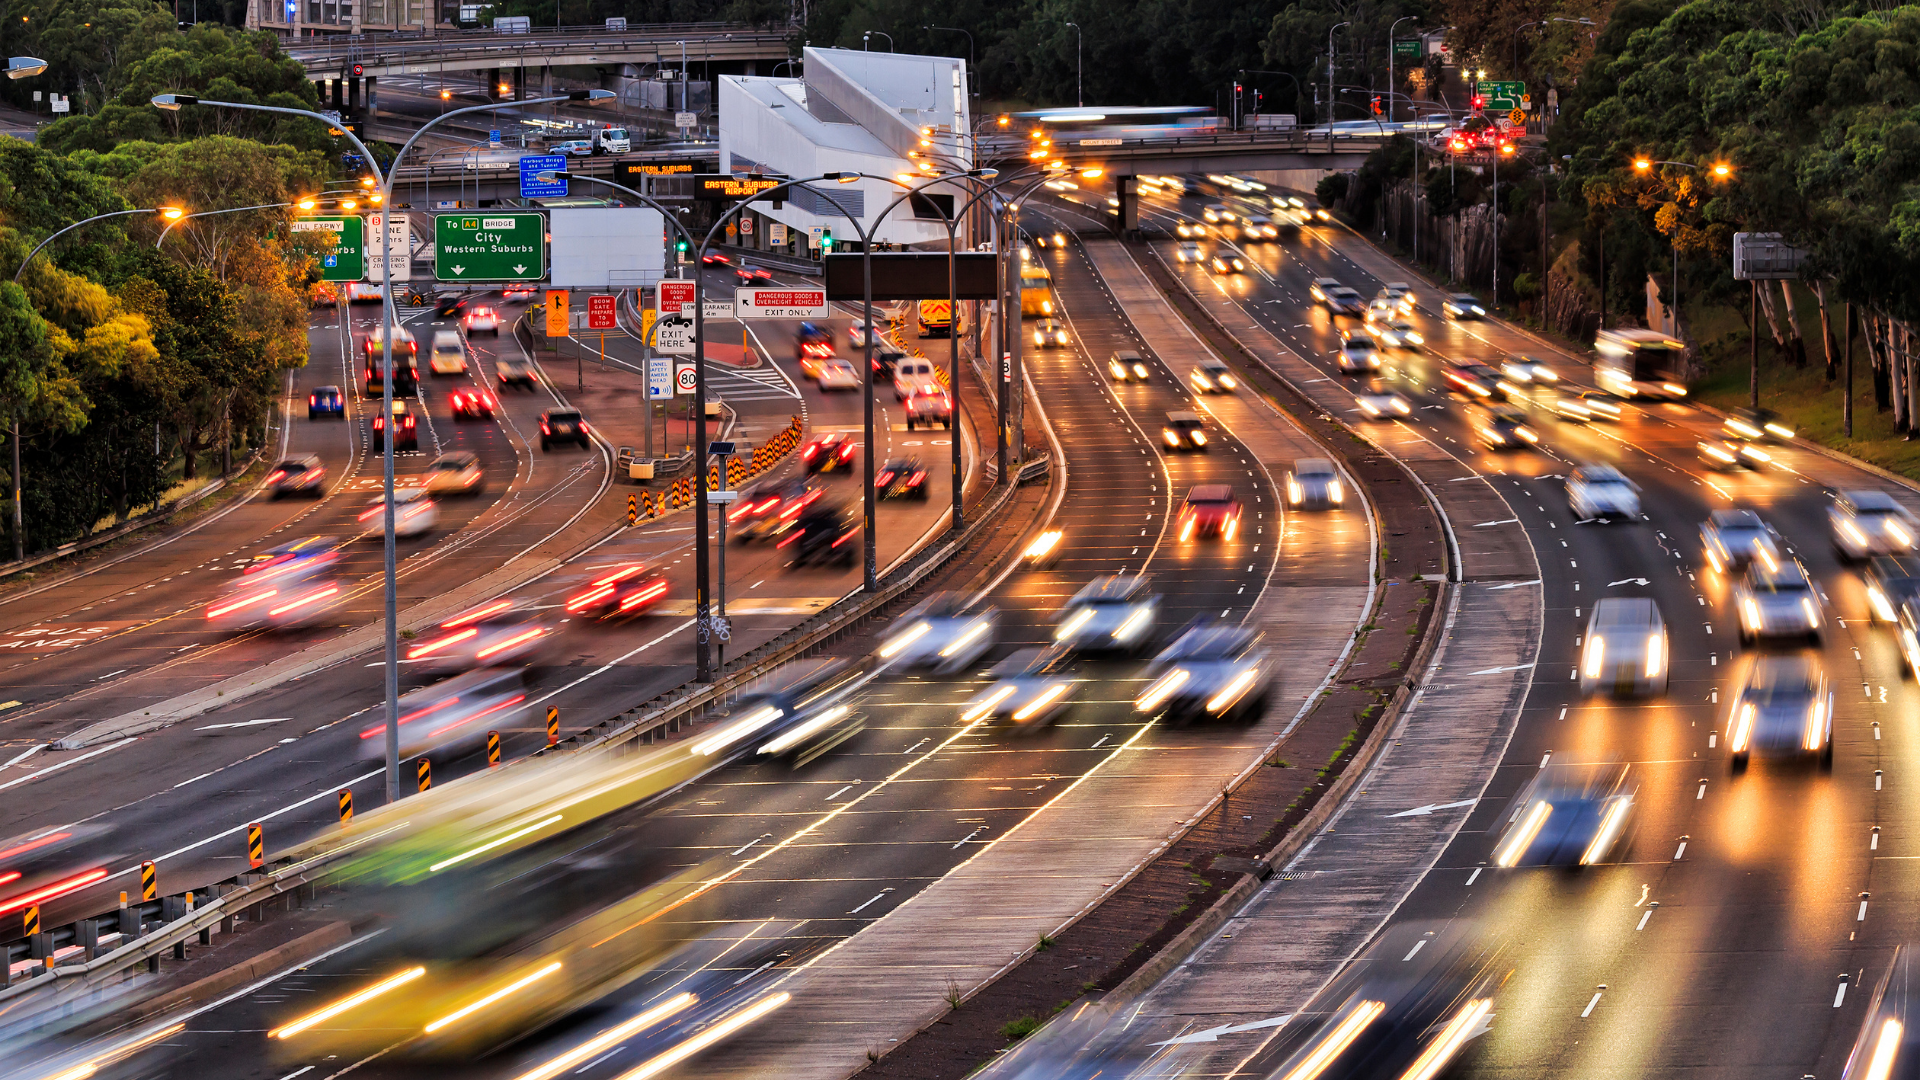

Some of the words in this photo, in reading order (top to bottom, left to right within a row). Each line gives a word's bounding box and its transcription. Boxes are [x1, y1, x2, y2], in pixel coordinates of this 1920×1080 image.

[704, 181, 740, 189] EASTERN
[743, 181, 779, 189] SUBURBS
[725, 187, 758, 195] AIRPORT
[313, 223, 342, 231] EXPWY
[446, 221, 458, 229] To
[464, 220, 477, 228] A4
[475, 232, 502, 244] City
[444, 245, 486, 254] Western
[491, 244, 534, 253] Suburbs
[660, 340, 685, 348] HERE
[681, 373, 696, 385] 80
[13, 626, 110, 637] BUS
[0, 638, 87, 648] ANE
